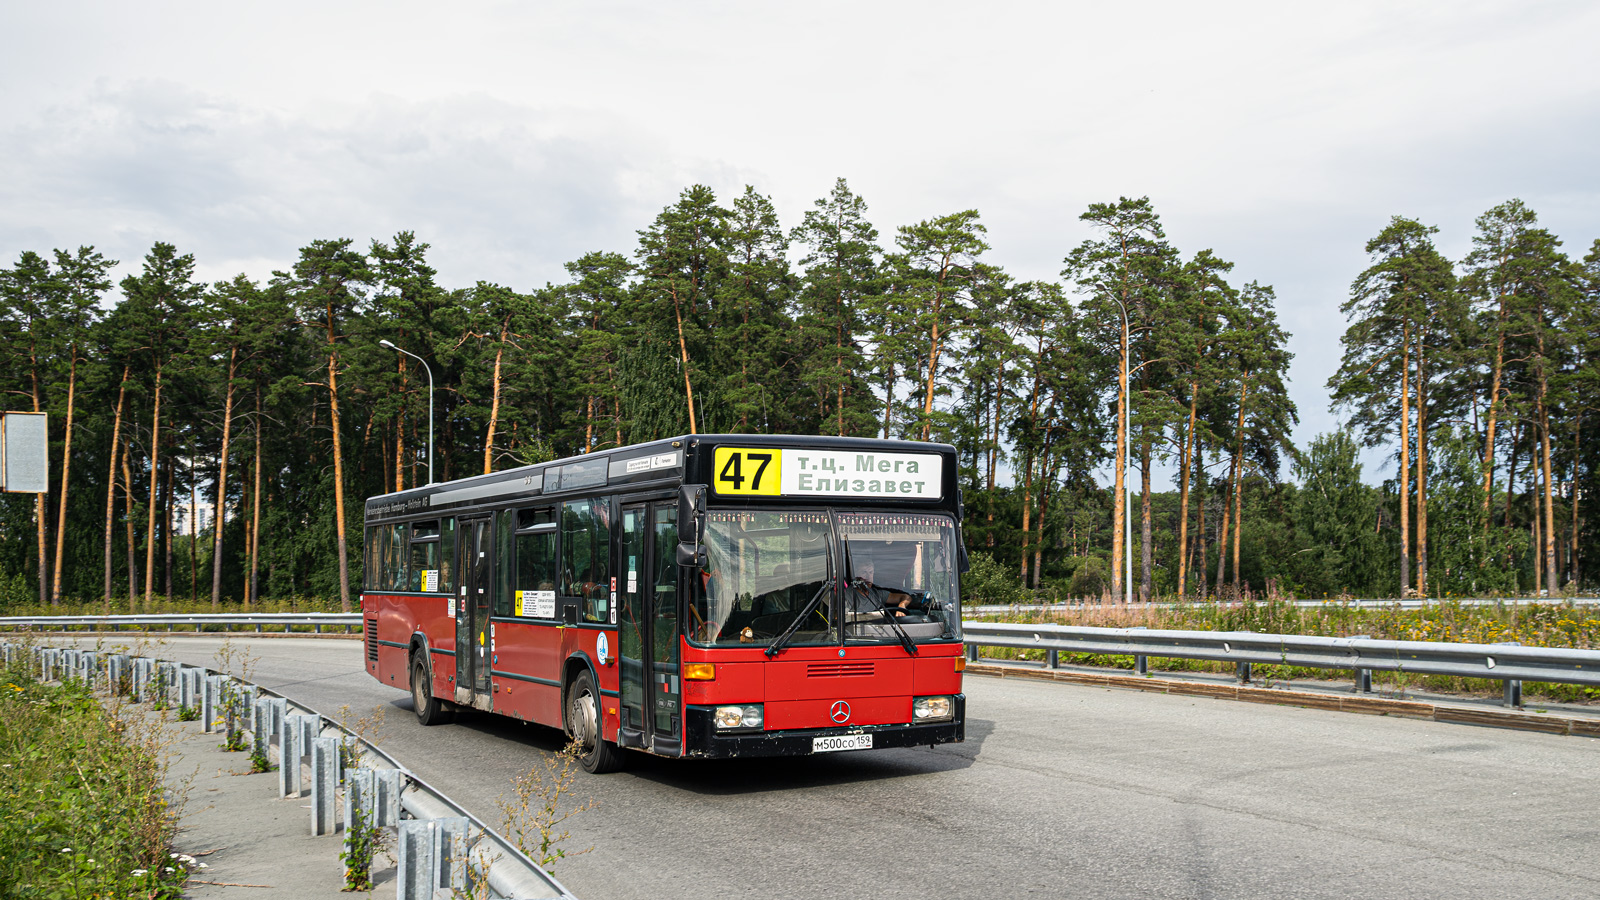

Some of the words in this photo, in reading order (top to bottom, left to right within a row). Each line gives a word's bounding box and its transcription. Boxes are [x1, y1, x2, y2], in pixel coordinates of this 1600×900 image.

[719, 452, 773, 490] 47
[798, 457, 845, 474] т.ц.
[856, 455, 919, 473] Мега
[798, 473, 926, 494] Елизавет
[856, 735, 871, 744] 159
